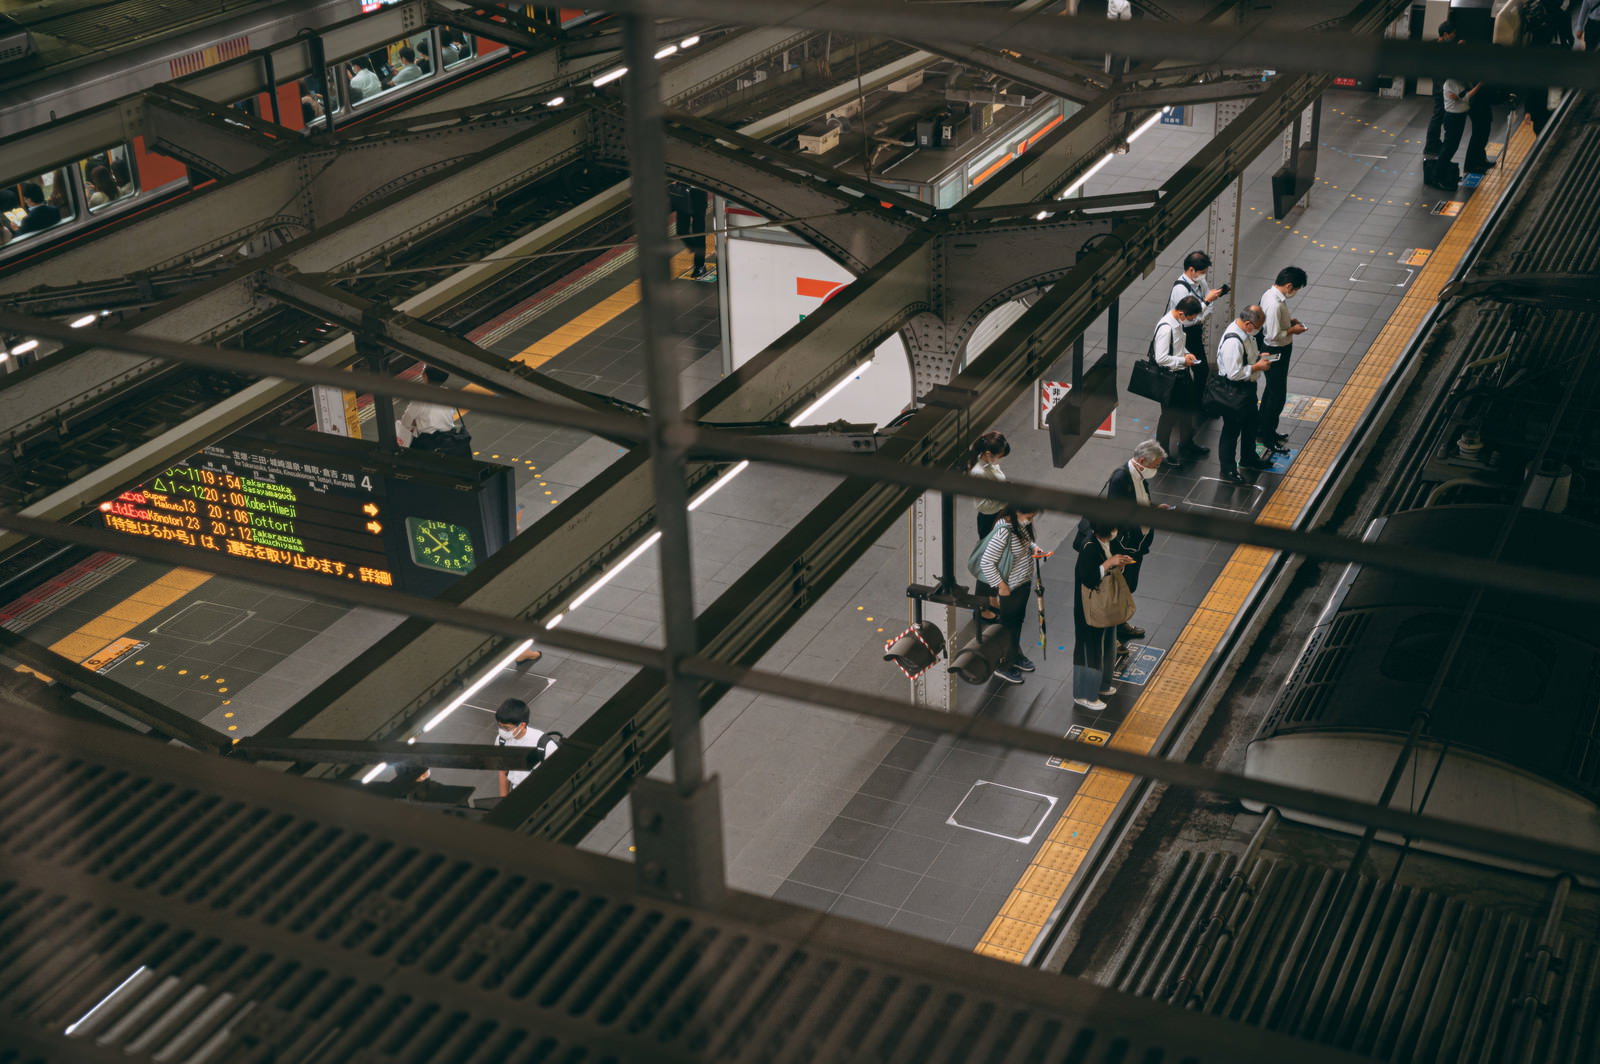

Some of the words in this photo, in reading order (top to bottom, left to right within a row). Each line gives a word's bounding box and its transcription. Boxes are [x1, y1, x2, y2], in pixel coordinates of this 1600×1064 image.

[240, 476, 293, 494] Takarazuka
[360, 475, 373, 492] 4
[204, 487, 245, 508] 20:00
[182, 499, 197, 514] 13
[207, 504, 249, 524] 20:06
[247, 512, 294, 533] Tottori
[185, 516, 200, 530] 23
[211, 521, 253, 541] 20:12
[251, 528, 303, 546] Takarazuka
[252, 535, 305, 553] Fukuchiyama
